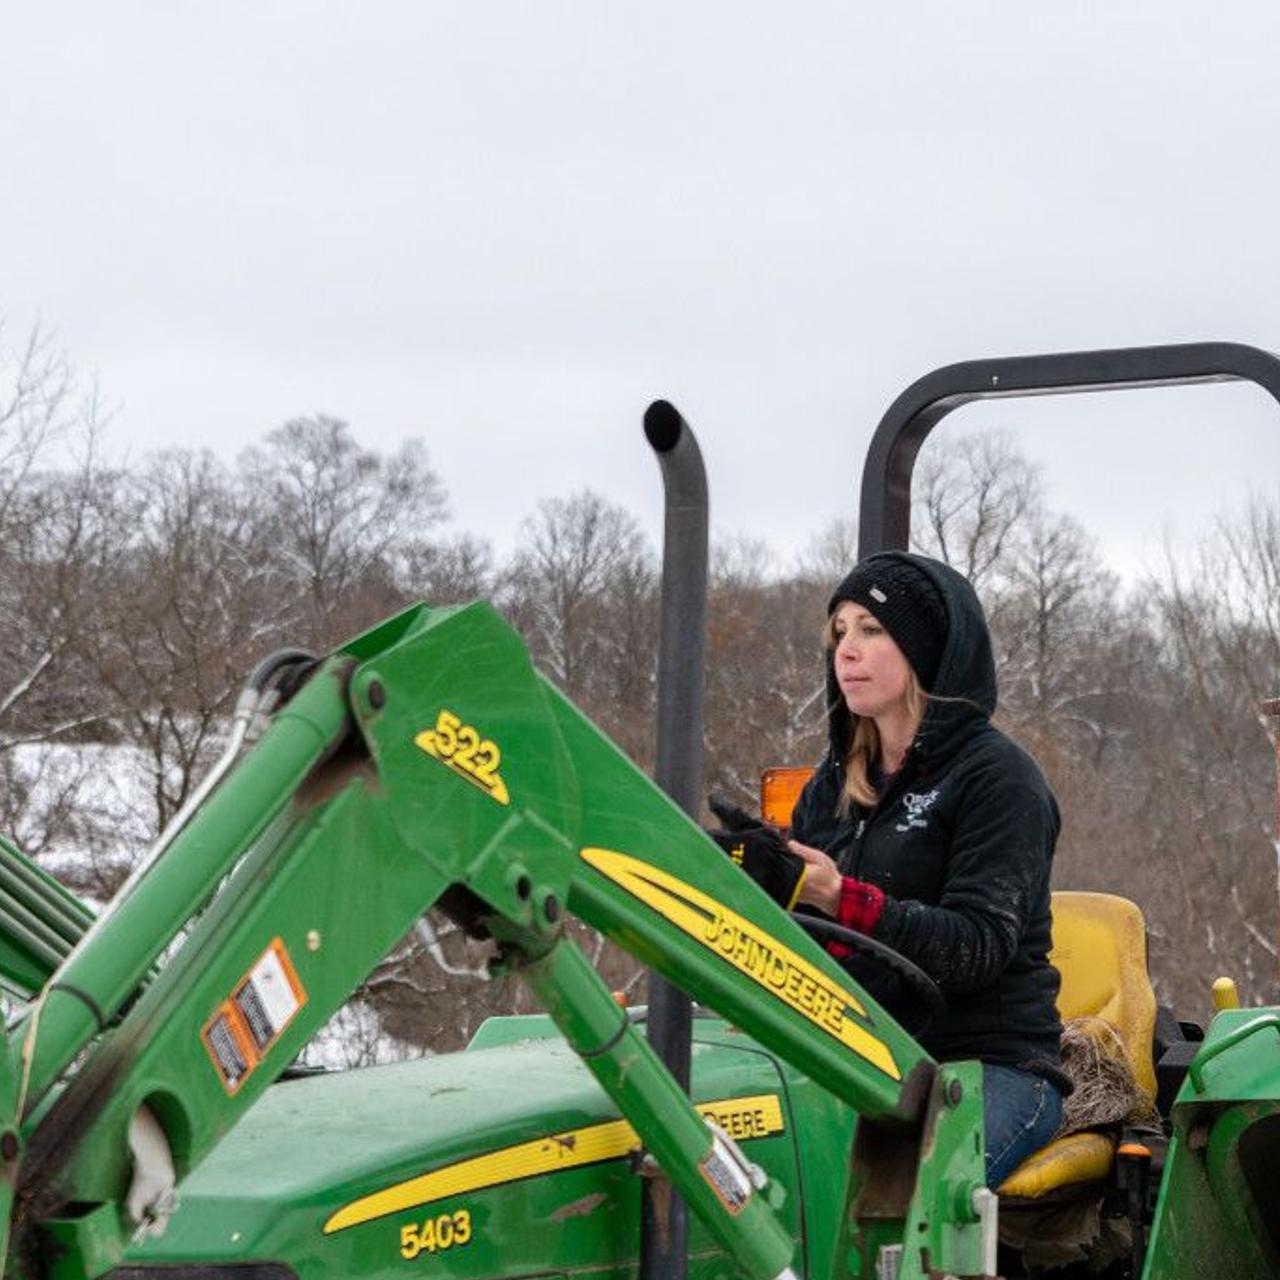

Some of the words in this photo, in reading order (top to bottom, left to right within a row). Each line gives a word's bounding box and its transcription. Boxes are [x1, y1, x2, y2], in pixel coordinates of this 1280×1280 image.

[436, 709, 500, 788] 522
[703, 913, 772, 979] JOHN
[765, 956, 849, 1033] DEERE
[400, 1210, 471, 1260] 5403
